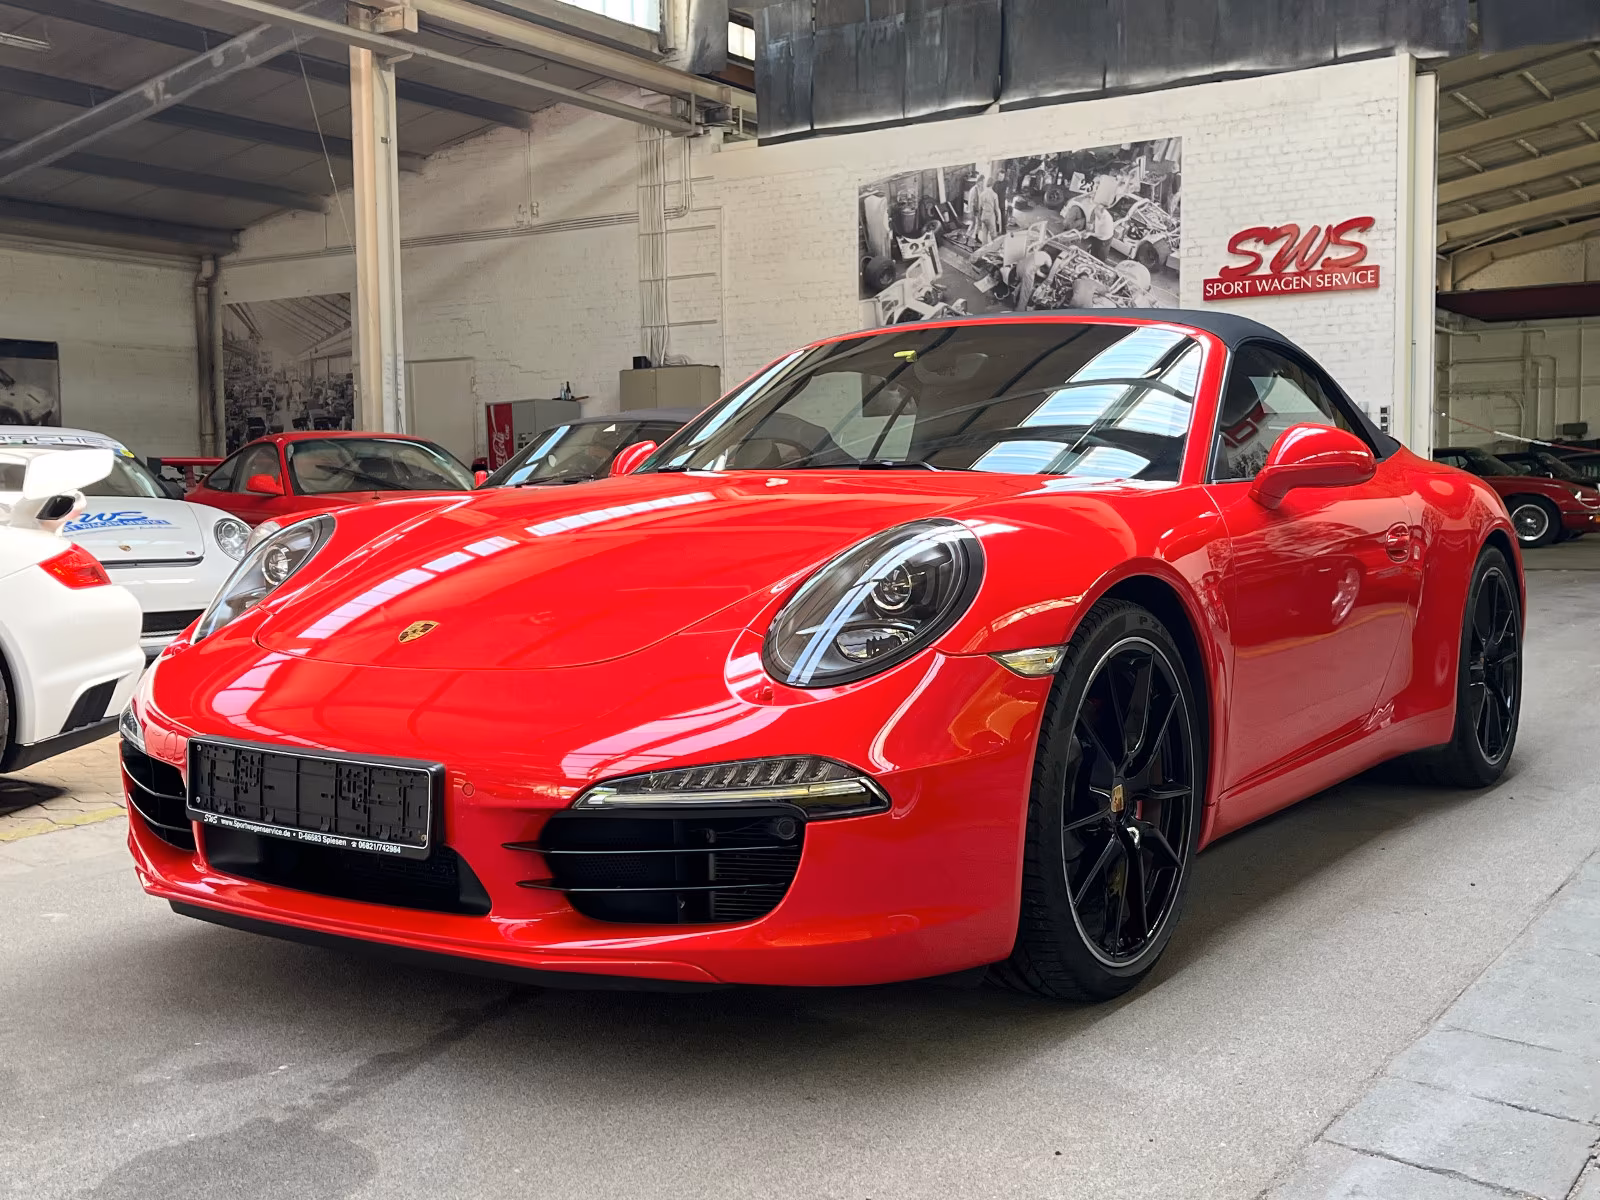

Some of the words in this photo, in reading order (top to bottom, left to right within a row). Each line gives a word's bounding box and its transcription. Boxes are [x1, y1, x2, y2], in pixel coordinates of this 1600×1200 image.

[1219, 216, 1375, 278] SWS
[1205, 280, 1252, 297] SPORT
[1255, 276, 1312, 293] WAGEN
[1315, 269, 1376, 288] SERVICE
[204, 814, 218, 824] SWS
[221, 818, 291, 838] www.Sportwagenservice.de
